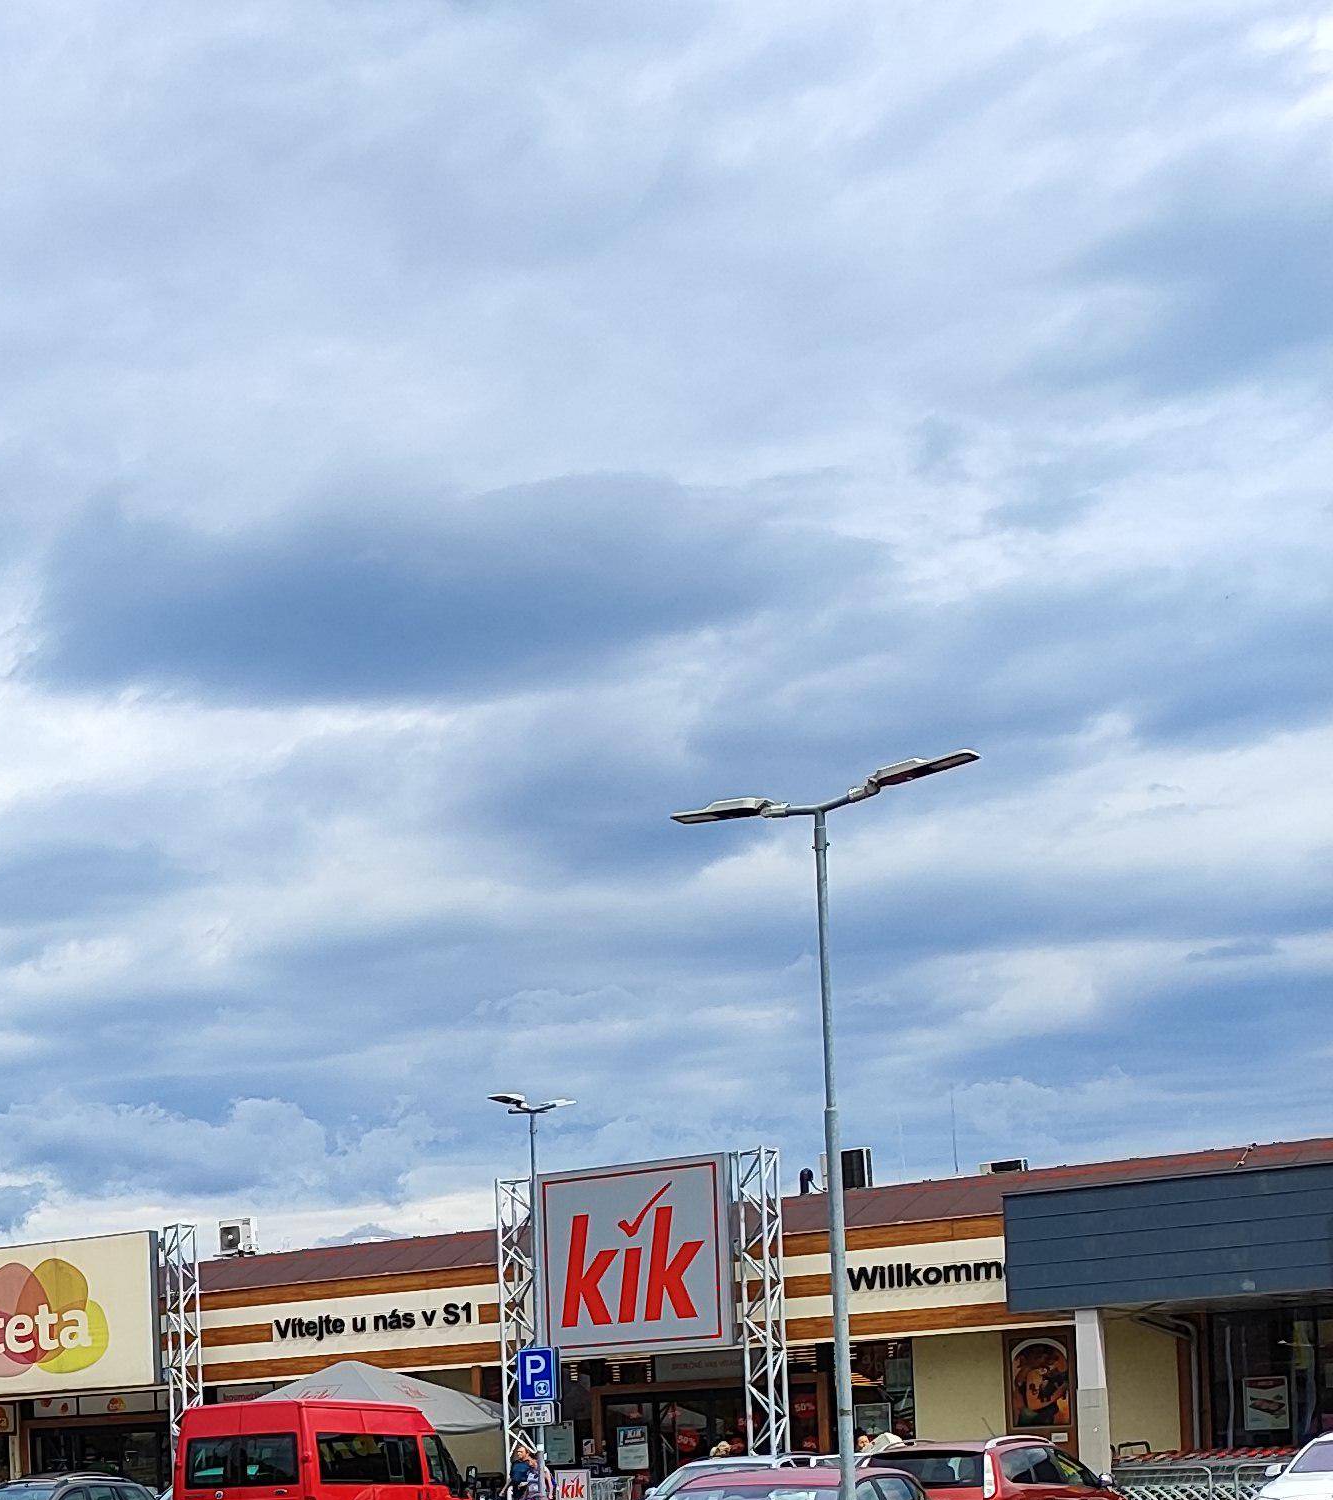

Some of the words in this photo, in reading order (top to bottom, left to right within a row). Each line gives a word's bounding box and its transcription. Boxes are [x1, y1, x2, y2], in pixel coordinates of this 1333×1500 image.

[561, 1180, 706, 1329] kik
[847, 1260, 1006, 1292] Willkomm
[273, 1313, 346, 1343] Vítejte
[351, 1316, 367, 1334] u
[374, 1308, 416, 1332] nás
[421, 1309, 437, 1328] v
[442, 1302, 473, 1326] S1
[525, 1354, 546, 1386] P
[561, 1474, 585, 1499] kik
